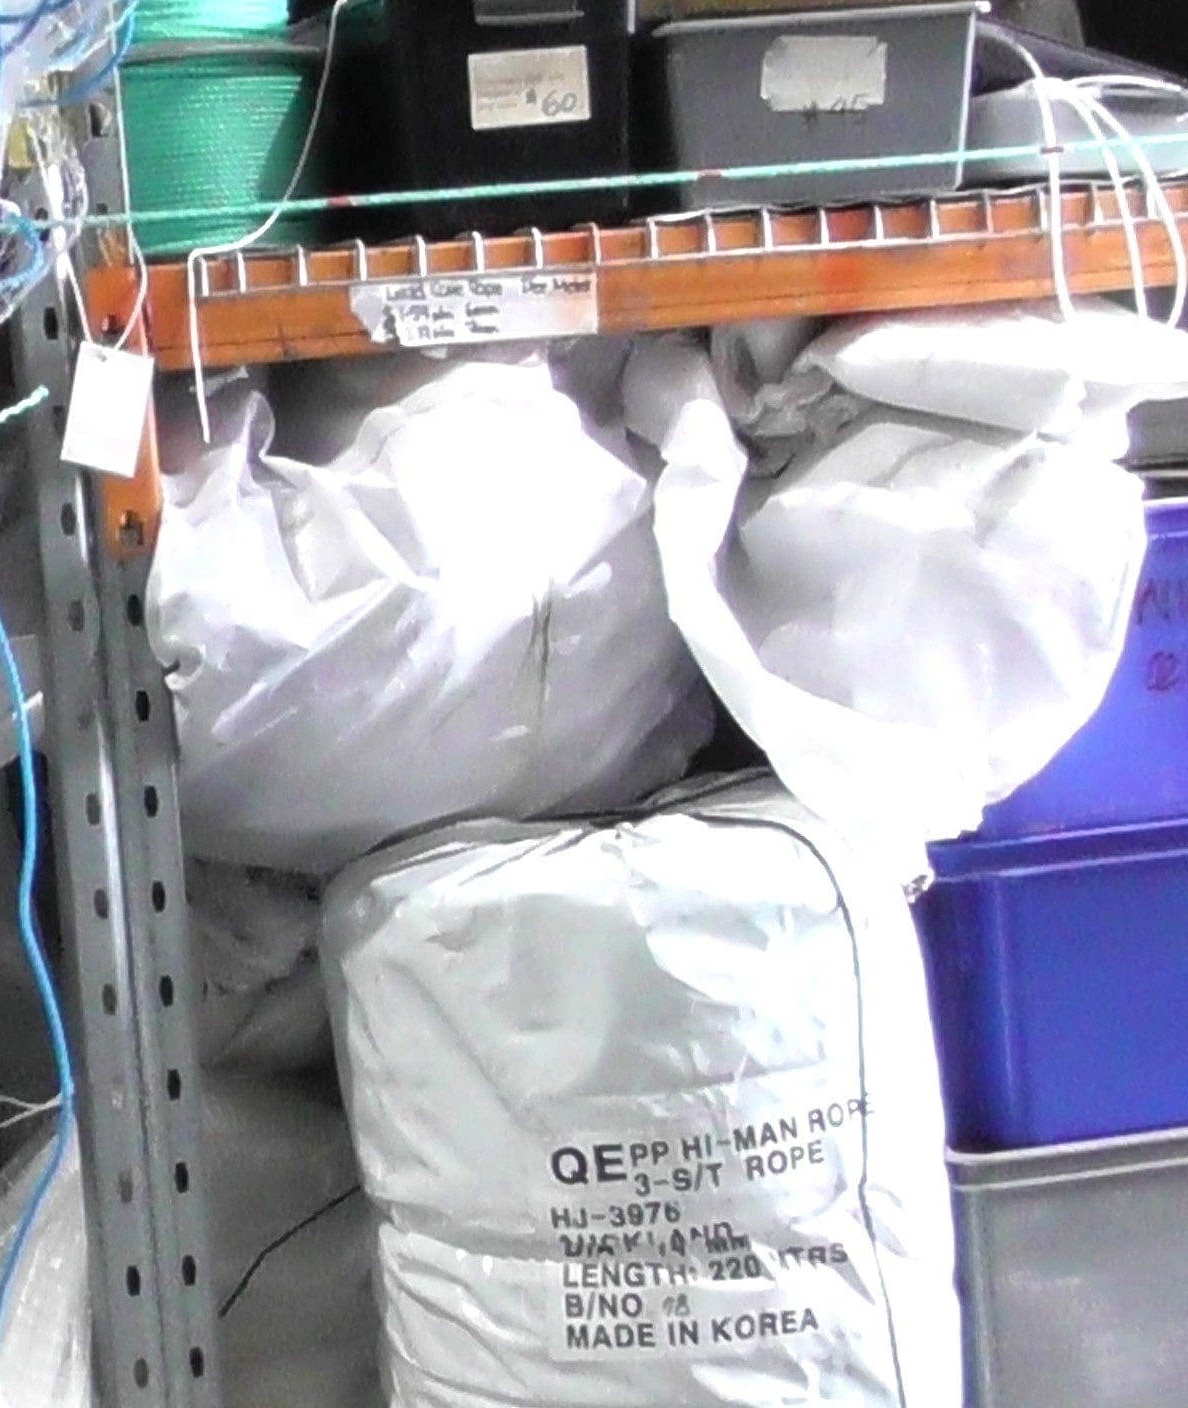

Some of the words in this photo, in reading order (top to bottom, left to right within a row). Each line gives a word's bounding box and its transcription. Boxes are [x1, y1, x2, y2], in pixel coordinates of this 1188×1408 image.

[629, 1141, 670, 1168] PP
[680, 1115, 798, 1161] HI-MAN
[550, 1143, 627, 1185] QE
[633, 1162, 724, 1197] 3-S/T
[744, 1138, 825, 1181] ROPE
[550, 1201, 681, 1229] HJ-3976
[708, 1254, 762, 1281] 220
[564, 1292, 643, 1321] B/NO
[566, 1323, 656, 1350] MADE
[667, 1320, 700, 1347] IN
[711, 1307, 819, 1344] KOREA
